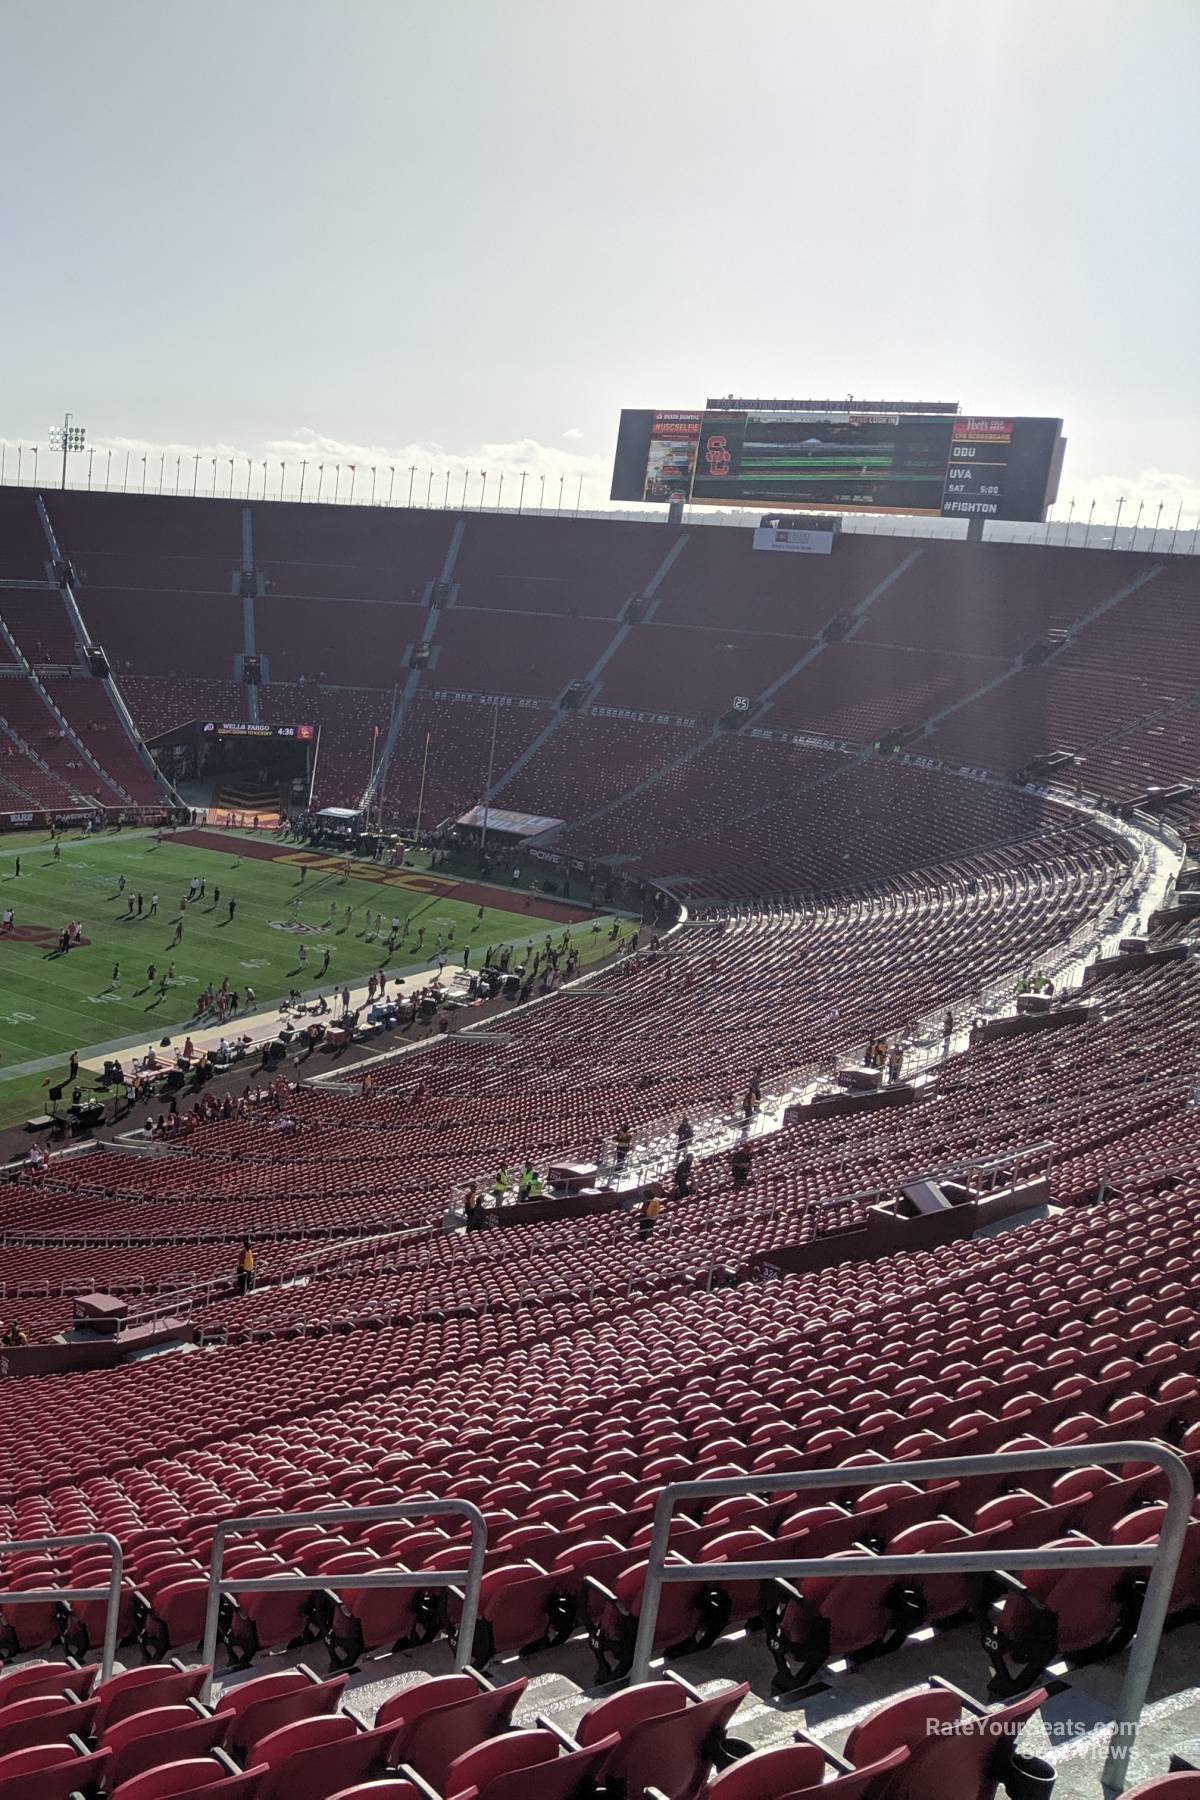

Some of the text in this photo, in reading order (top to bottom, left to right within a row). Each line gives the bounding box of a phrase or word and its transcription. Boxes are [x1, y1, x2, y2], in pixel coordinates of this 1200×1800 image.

[953, 447, 975, 457] ODU
[949, 469, 972, 479] UVA
[944, 502, 997, 513] #FIGHTON
[735, 699, 747, 708] 25
[529, 848, 585, 871] POWEDE
[272, 851, 461, 892] USC
[0, 1011, 36, 1025] 30
